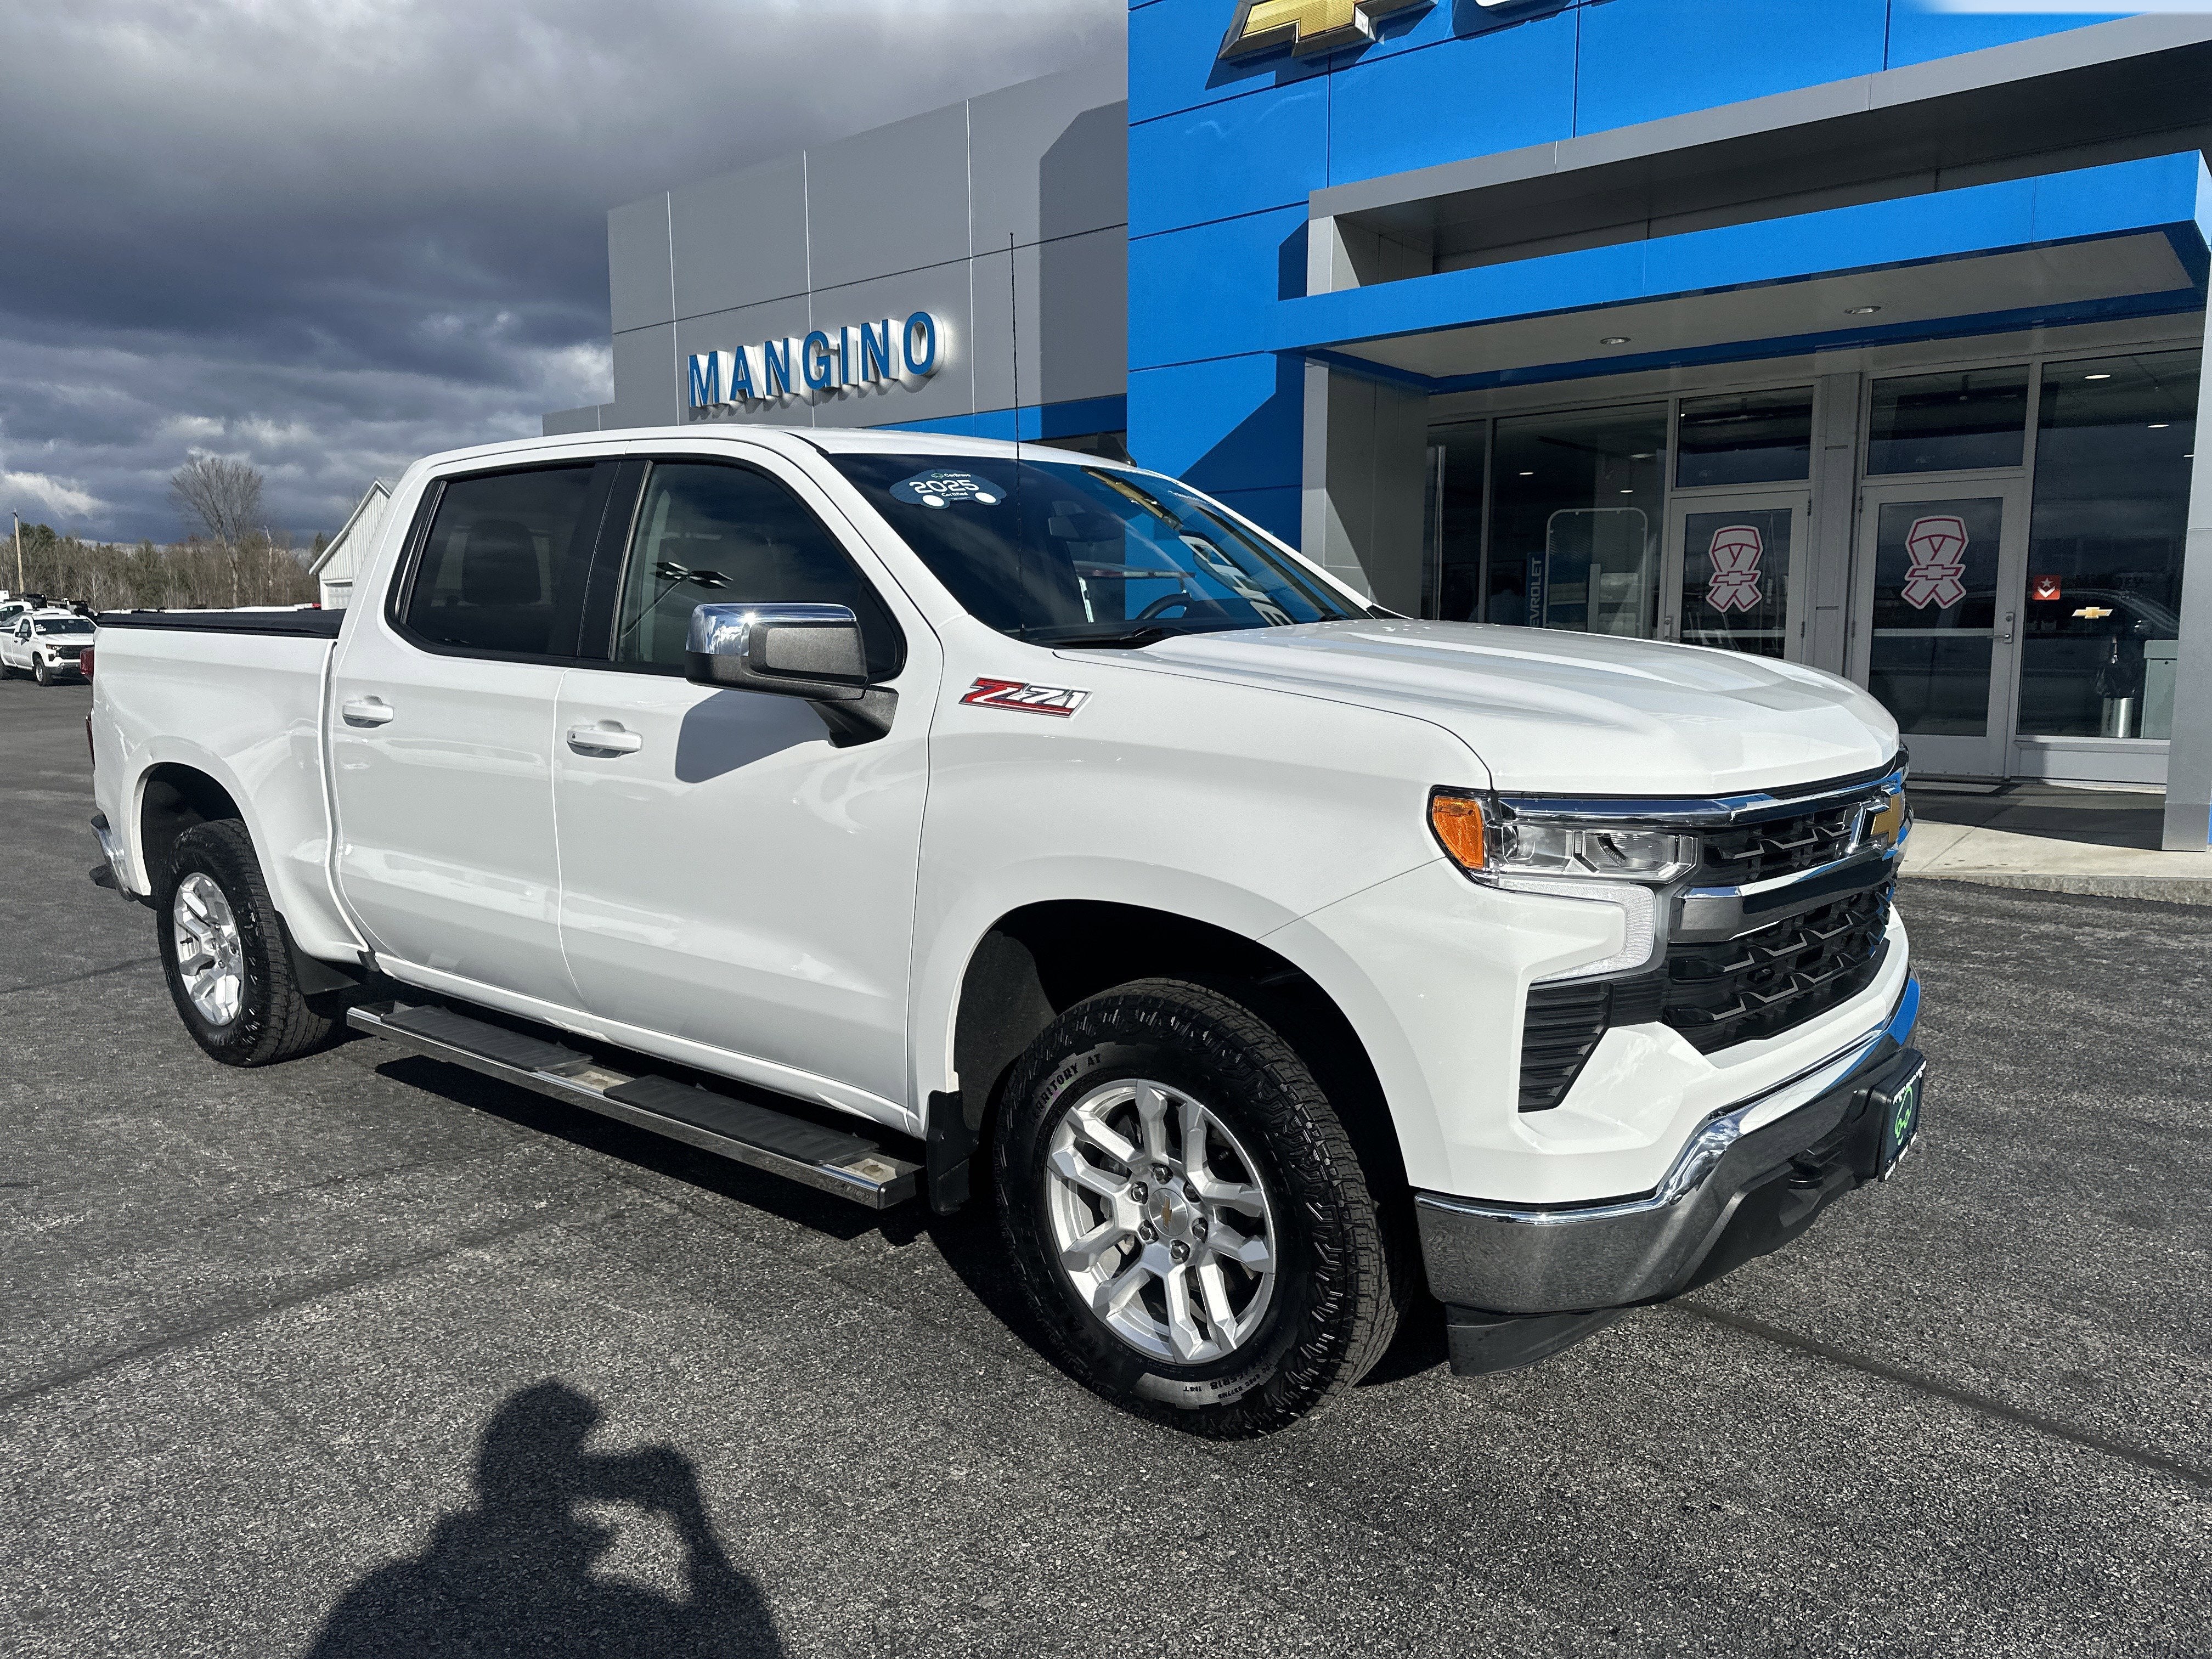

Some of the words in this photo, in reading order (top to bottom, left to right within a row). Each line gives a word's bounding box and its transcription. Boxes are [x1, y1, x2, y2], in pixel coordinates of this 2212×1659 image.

[689, 312, 940, 408] MANGINO
[909, 479, 979, 494] 2025
[958, 675, 1093, 718] Z71
[1087, 1053, 1102, 1067] AT
